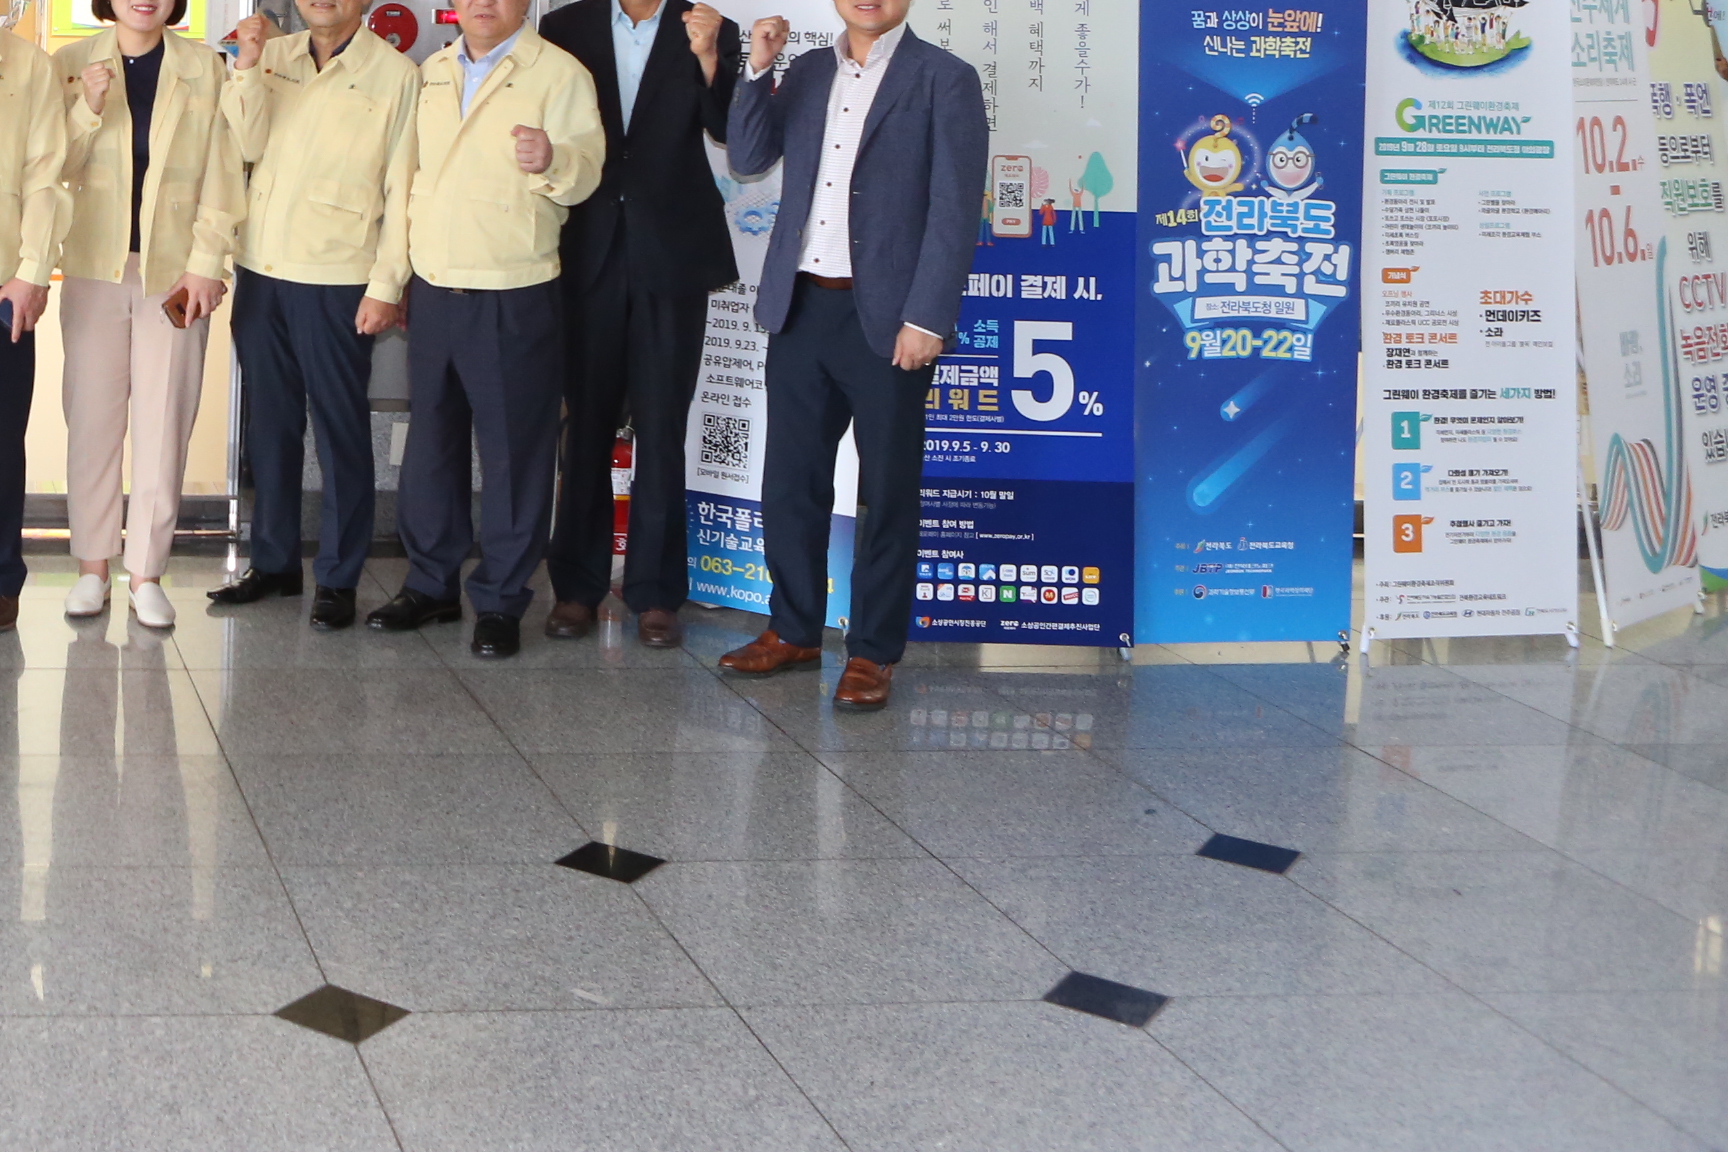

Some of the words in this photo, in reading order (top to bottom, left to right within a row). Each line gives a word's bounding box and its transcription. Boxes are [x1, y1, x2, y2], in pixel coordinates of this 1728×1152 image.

[1191, 10, 1219, 30] 꿈과
[1222, 10, 1263, 31] 상상이
[1267, 8, 1324, 33] 눈앞에!
[804, 31, 835, 46] 핵심!
[1203, 34, 1246, 58] 신나는
[1249, 35, 1312, 59] 과학축전
[1028, 20, 1046, 93] 혜택까지
[1571, 29, 1636, 74] 소리축제
[1428, 99, 1454, 111] 제12회
[1395, 97, 1524, 136] GREENWAY
[1155, 208, 1200, 228] 제14회
[1200, 196, 1337, 240] 전라북도
[1152, 236, 1352, 298] 과학축전
[962, 272, 1013, 298] 페이
[1020, 274, 1067, 300] 결제
[1479, 289, 1534, 306] 초대가수
[711, 299, 750, 314] 미취업자
[1220, 300, 1273, 315] 전라북도청
[1274, 301, 1296, 315] 일원
[1485, 309, 1542, 323] 먼데이키즈
[973, 319, 1000, 334] 소득
[1485, 327, 1503, 338] 소라
[973, 334, 1000, 349] 공제
[1383, 332, 1403, 345] 환경
[1405, 333, 1425, 345] 토크
[1428, 333, 1459, 345] 콘서트
[703, 353, 754, 371] 공유압제어,
[1386, 359, 1403, 369] 환경
[1405, 359, 1422, 369] 토크
[1424, 359, 1450, 369] 콘서트
[701, 390, 730, 405] 온라인
[733, 394, 752, 408] 접수
[1382, 388, 1420, 400] 그린웨이
[1422, 388, 1467, 400] 환경축제를
[1469, 388, 1497, 400] 즐기는
[1500, 387, 1531, 399] 세가지
[1534, 388, 1556, 400] 방법!
[1400, 420, 1411, 438] 1
[1400, 471, 1413, 489] 2
[1401, 523, 1414, 542] 3
[1192, 563, 1224, 574] JBTP
